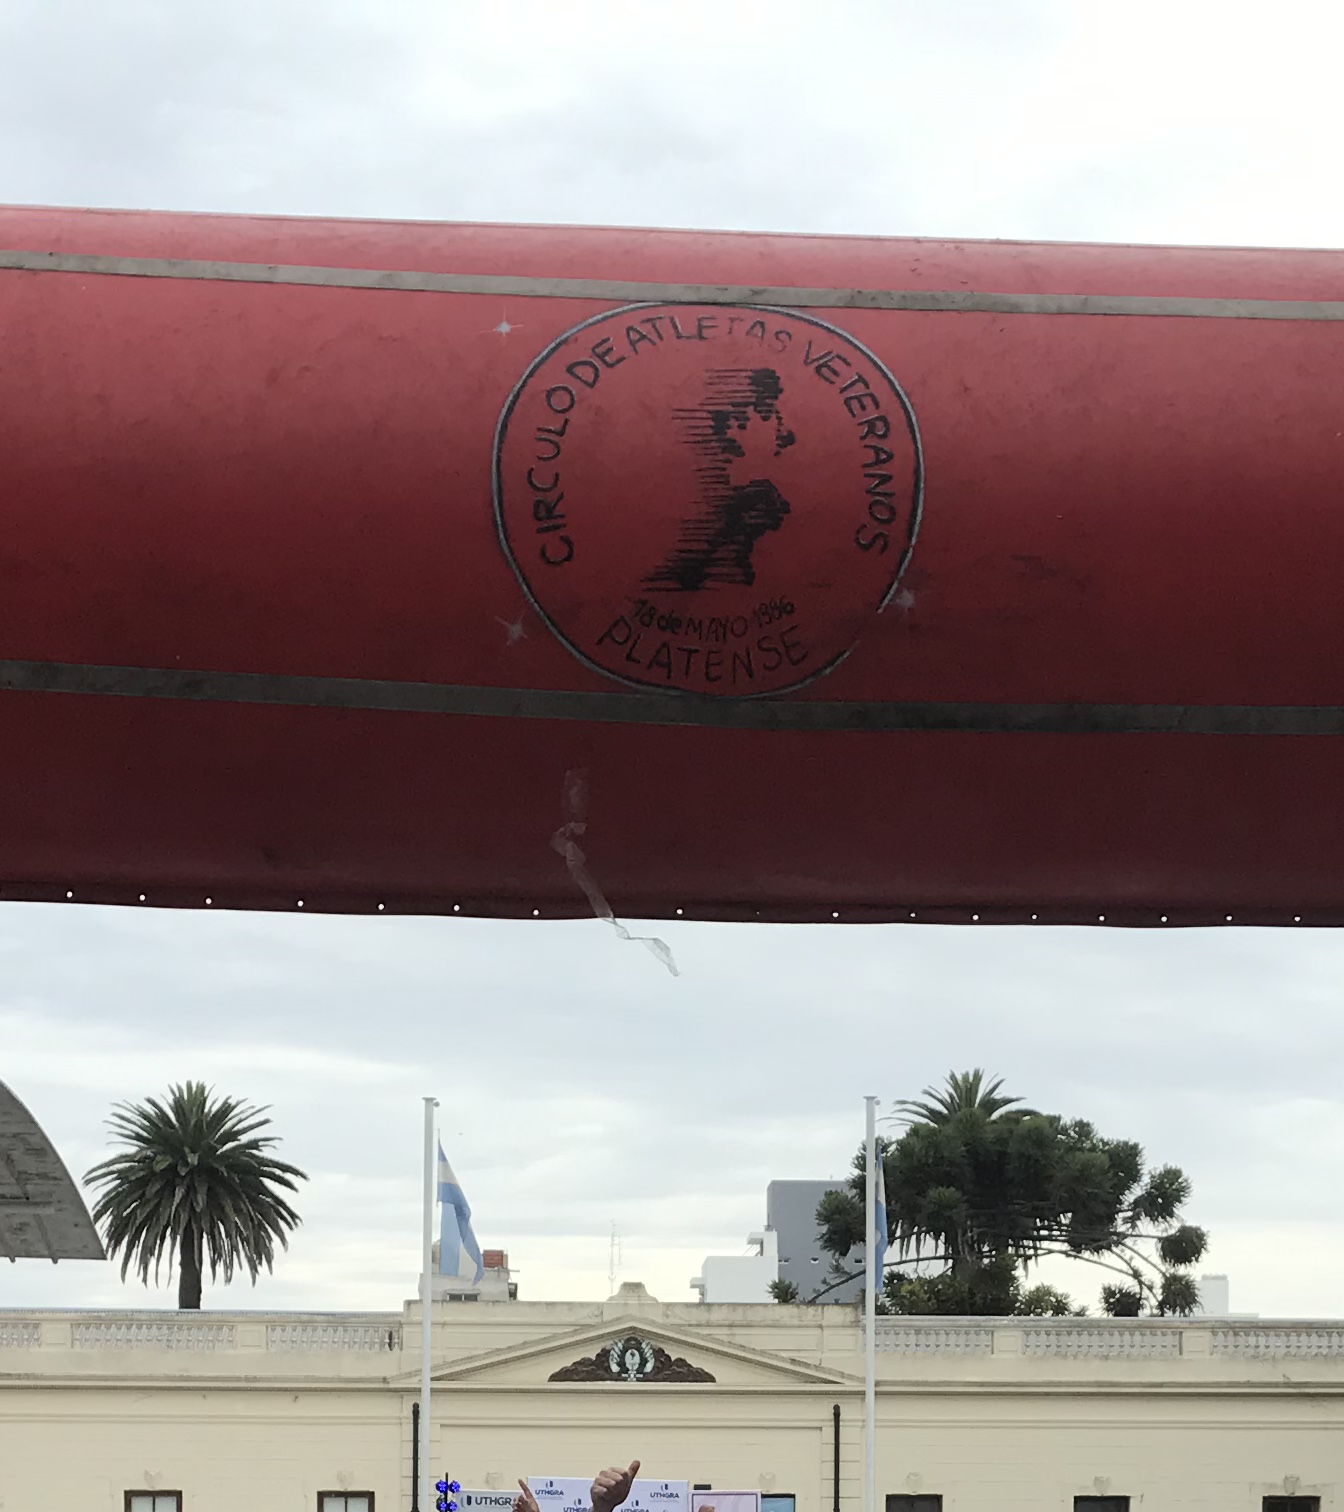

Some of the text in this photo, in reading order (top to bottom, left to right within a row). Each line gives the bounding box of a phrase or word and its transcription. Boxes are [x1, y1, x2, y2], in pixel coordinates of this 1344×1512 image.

[527, 384, 576, 567] CIRCULO
[625, 314, 792, 355] ATLETAS
[805, 340, 897, 556] VETERANOS
[595, 615, 809, 685] PLATENSE
[475, 1496, 513, 1506] UTHGR
